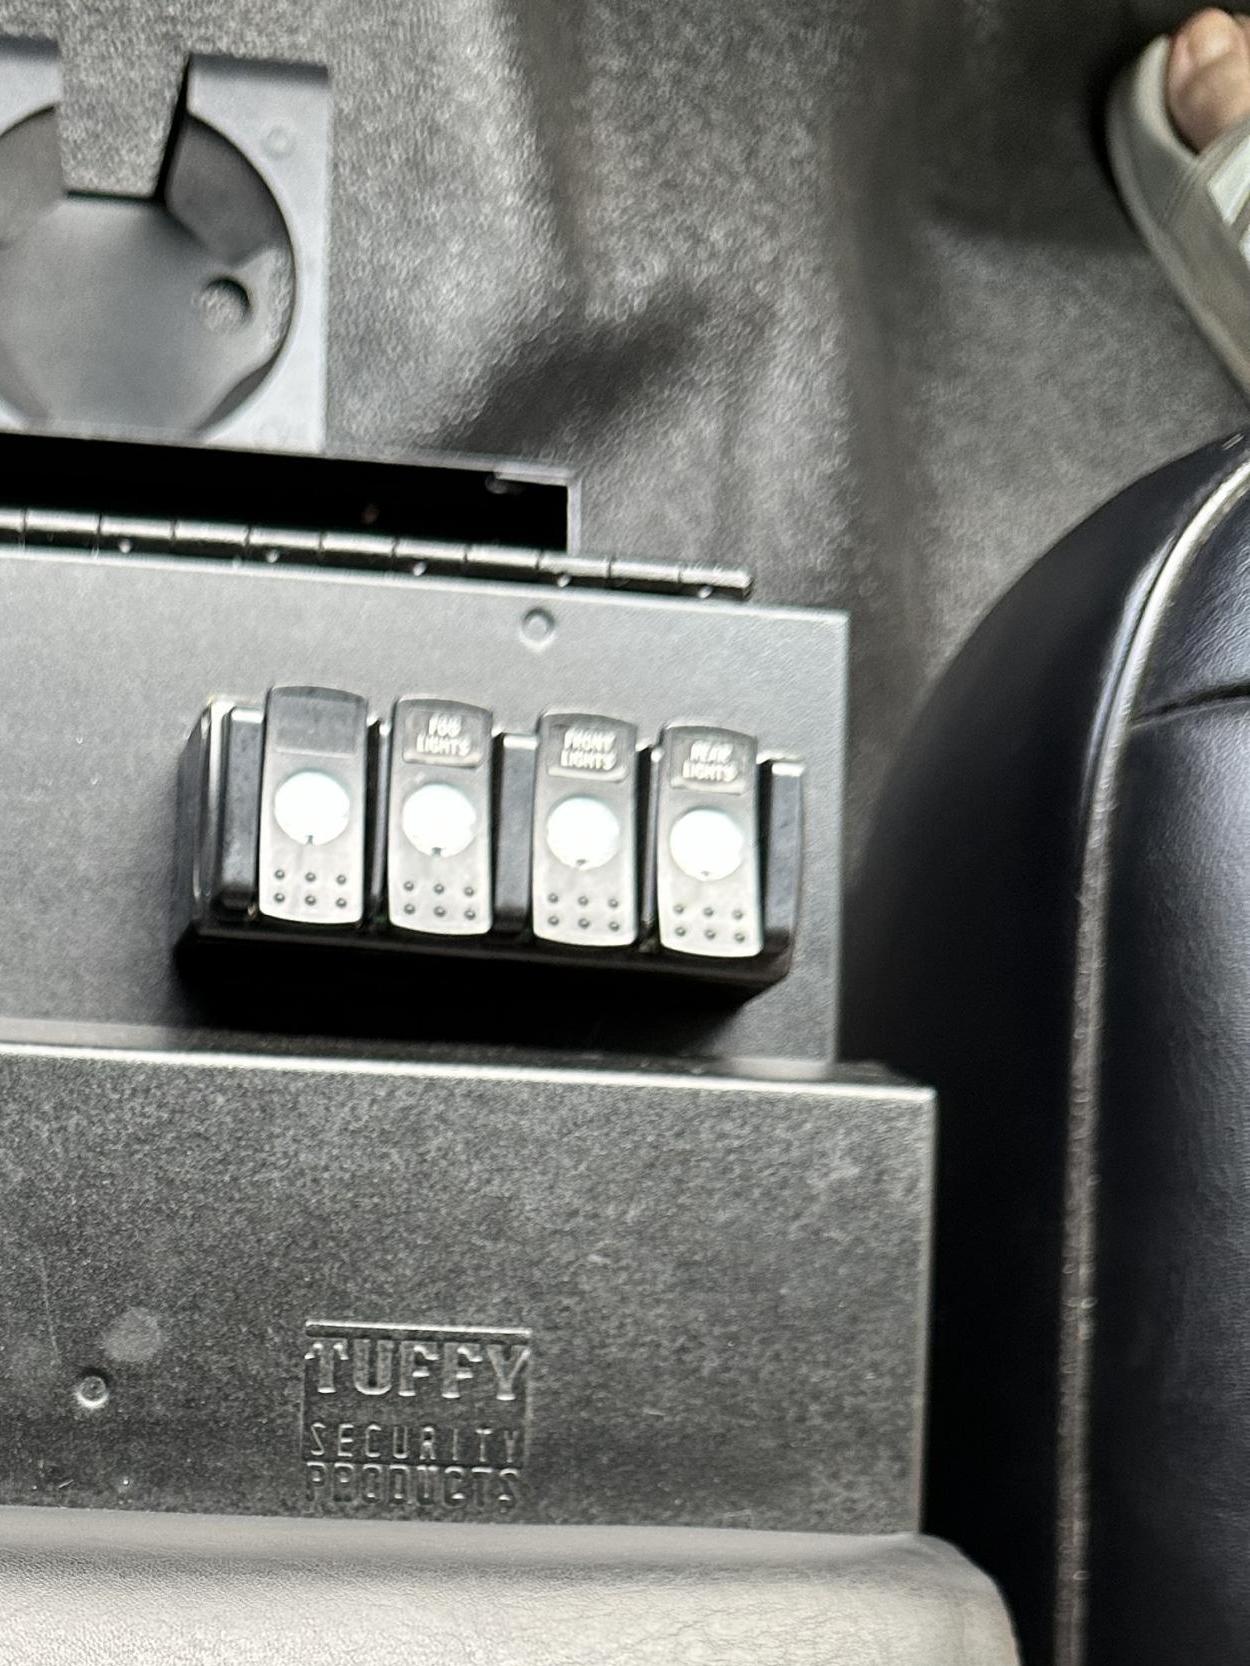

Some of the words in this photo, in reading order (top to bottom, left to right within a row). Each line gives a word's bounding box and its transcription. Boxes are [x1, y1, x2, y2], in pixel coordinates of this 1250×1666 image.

[416, 731, 471, 756] LIGHTS
[561, 749, 618, 771] LIGHTS
[682, 759, 738, 782] LIGHTS
[304, 1338, 531, 1401] TUFFY
[310, 1422, 519, 1463] SECURITY
[305, 1461, 527, 1508] PRODUCTS
